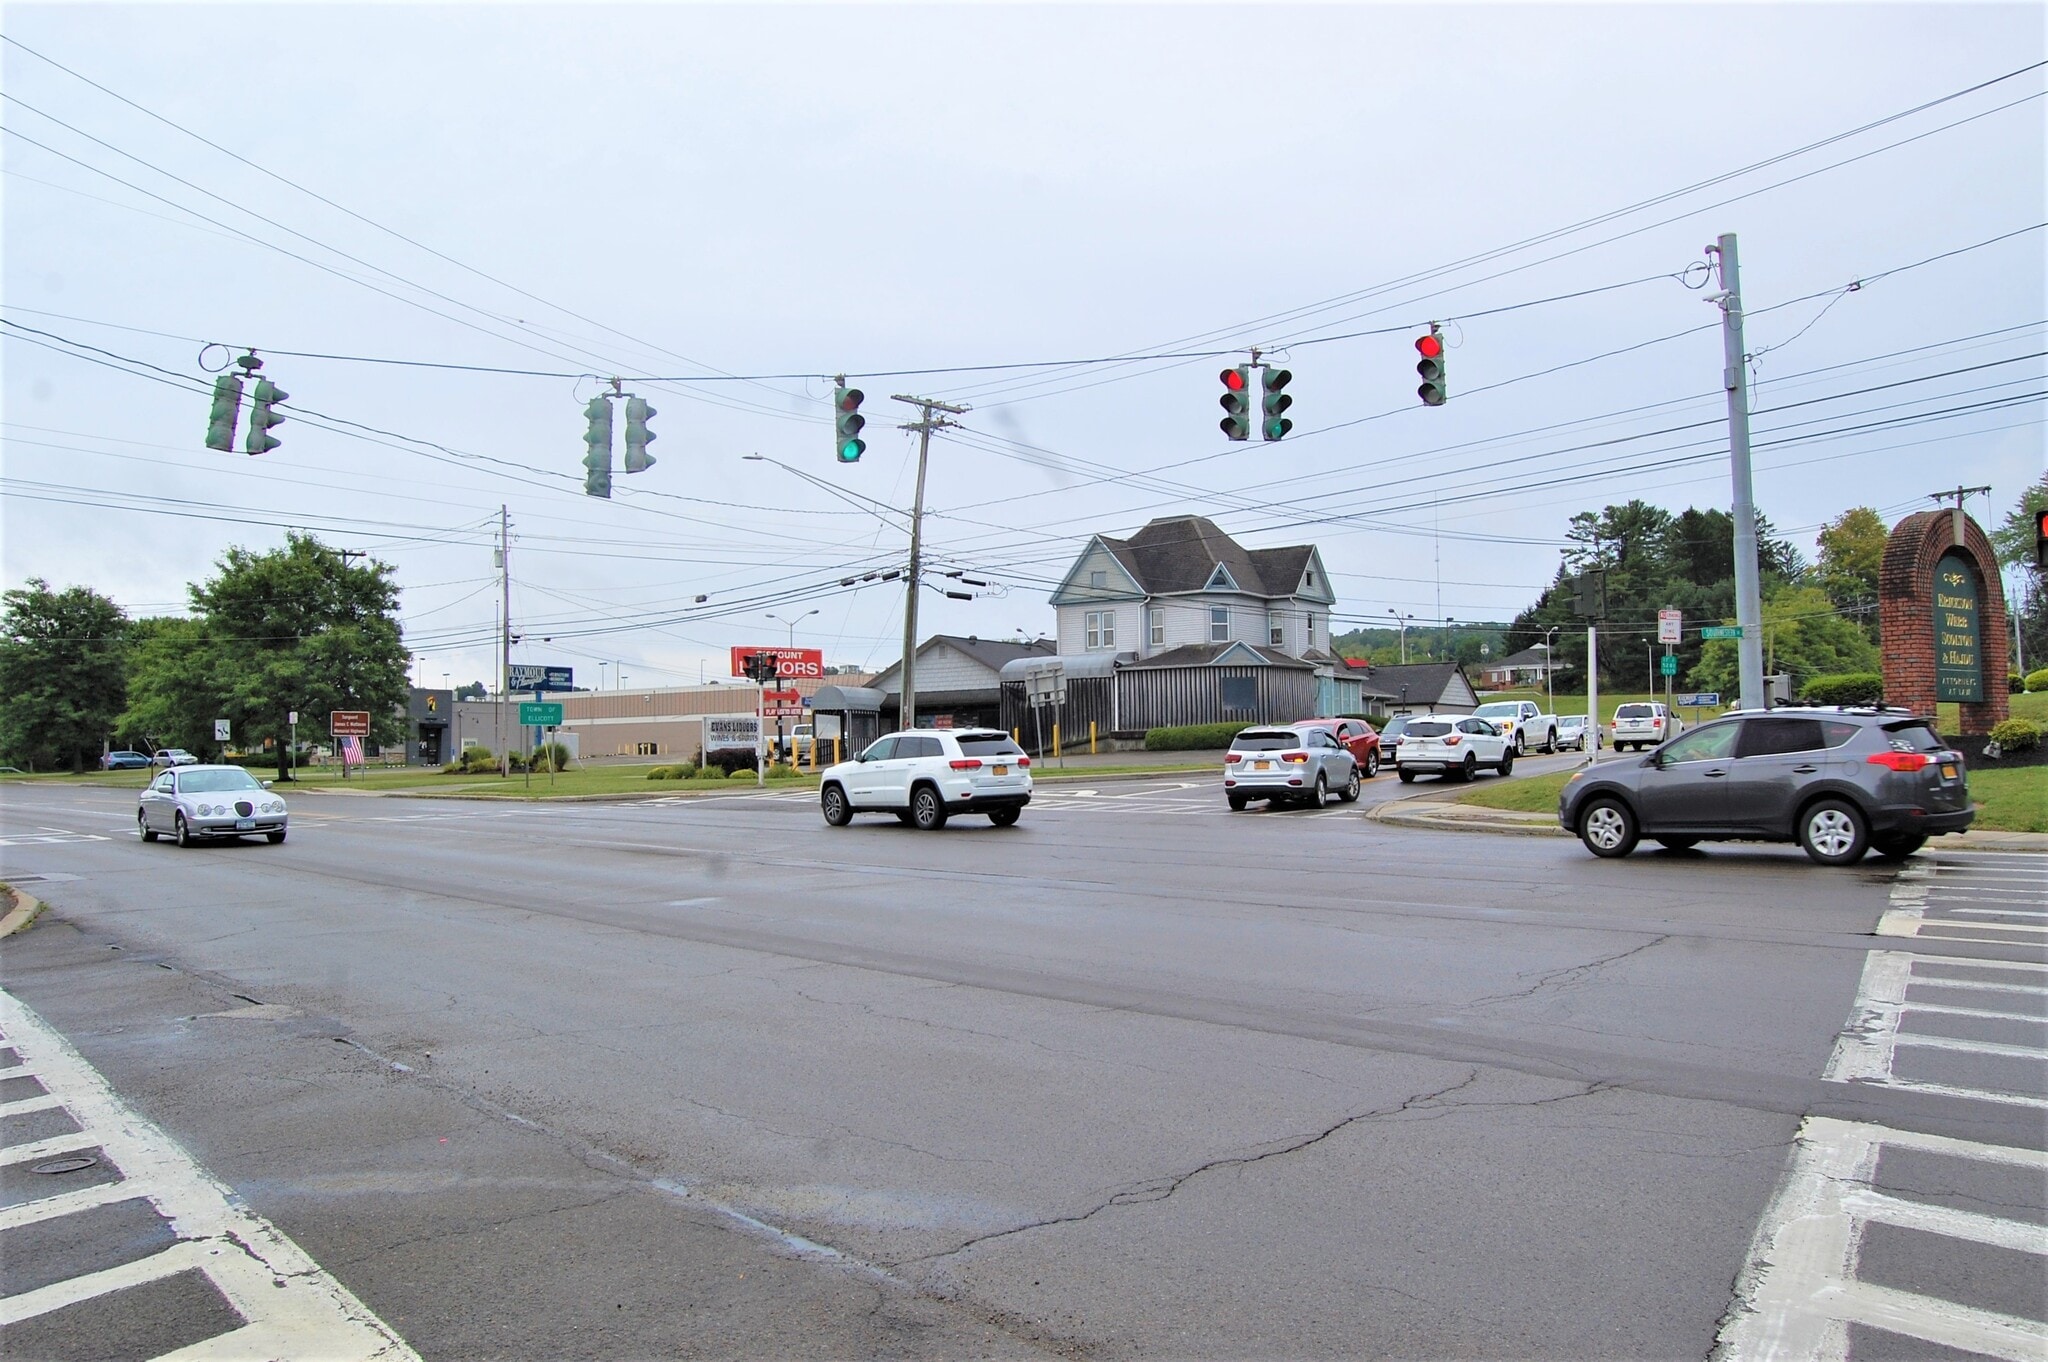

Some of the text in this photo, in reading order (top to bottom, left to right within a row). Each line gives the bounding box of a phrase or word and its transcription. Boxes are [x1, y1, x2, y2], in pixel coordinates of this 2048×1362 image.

[1938, 594, 1973, 610] ERICKSON
[1945, 613, 1968, 628] WEBB
[757, 651, 803, 659] SCOUNT
[1942, 651, 1974, 665] & HAJDU
[509, 666, 546, 679] RAYMOUR
[739, 661, 818, 675] LORS
[1942, 677, 1976, 686] ATTORNEYS
[1949, 688, 1971, 696] AT LAW
[711, 722, 758, 732] EVANS LIQUORS
